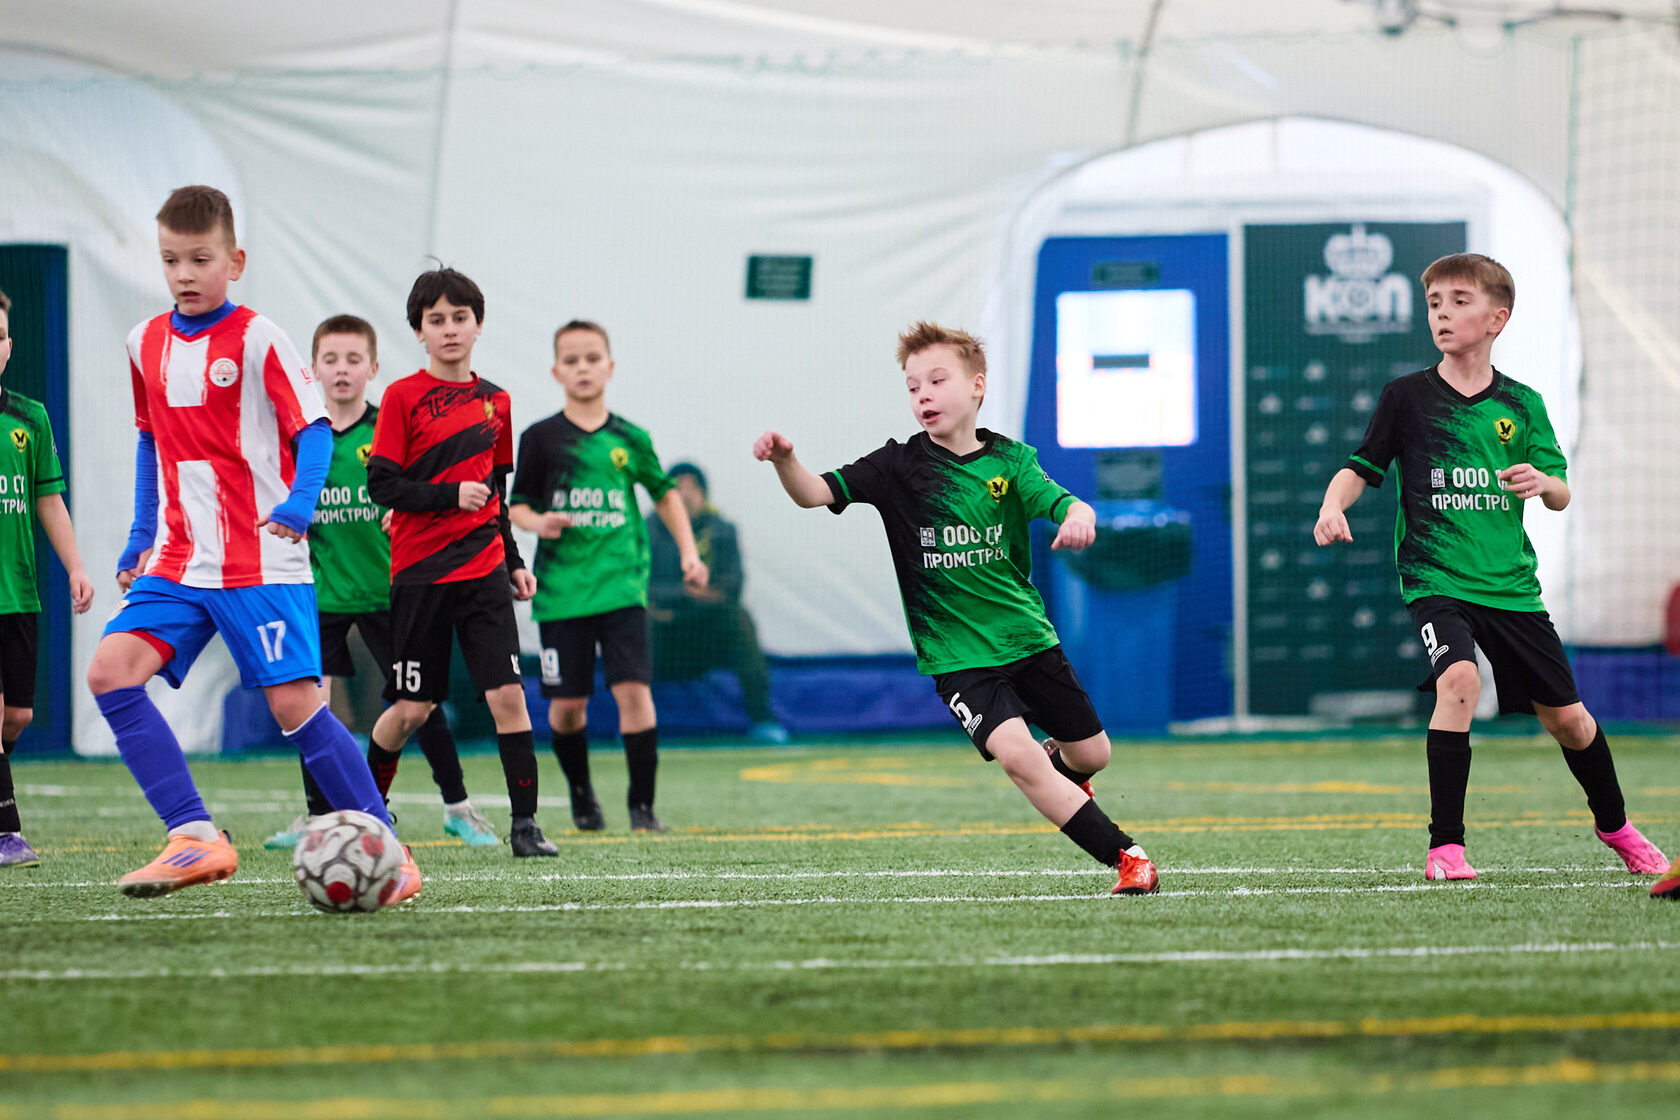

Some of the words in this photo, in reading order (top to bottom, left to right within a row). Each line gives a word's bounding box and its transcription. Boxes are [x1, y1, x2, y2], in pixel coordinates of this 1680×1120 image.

[357, 485, 373, 504] С
[1431, 493, 1510, 511] ПРОМСТРО
[923, 547, 1008, 569] ПРОМСТРО
[257, 620, 287, 663] 17
[1421, 621, 1438, 657] 9
[392, 660, 422, 693] 15
[949, 691, 973, 729] 5
